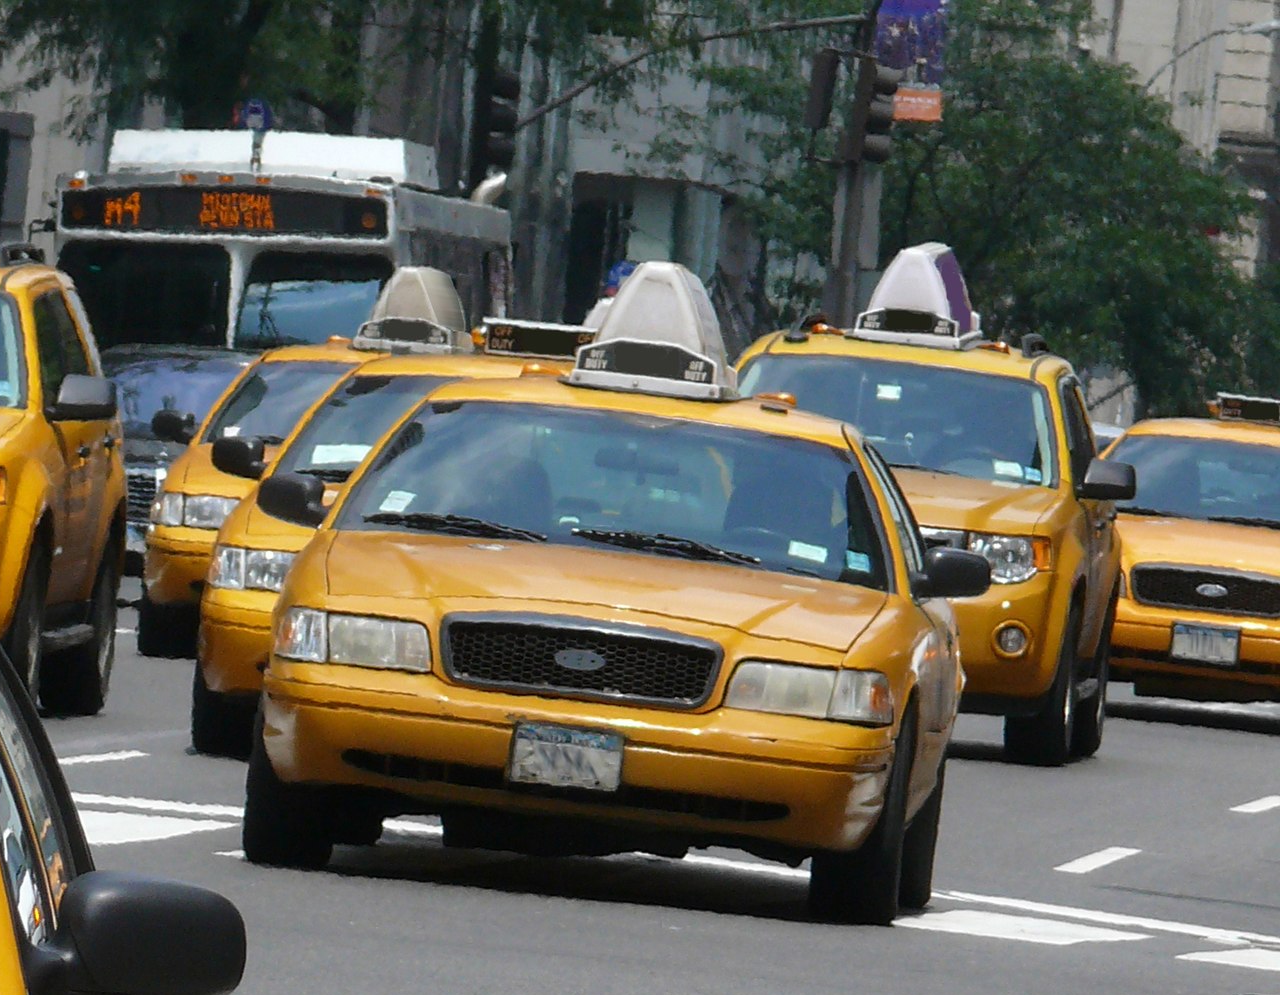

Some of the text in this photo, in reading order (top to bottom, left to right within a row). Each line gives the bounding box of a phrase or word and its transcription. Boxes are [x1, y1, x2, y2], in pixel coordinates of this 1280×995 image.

[104, 191, 142, 226] M4
[494, 325, 513, 337] OFF
[491, 337, 516, 350] DUTY
